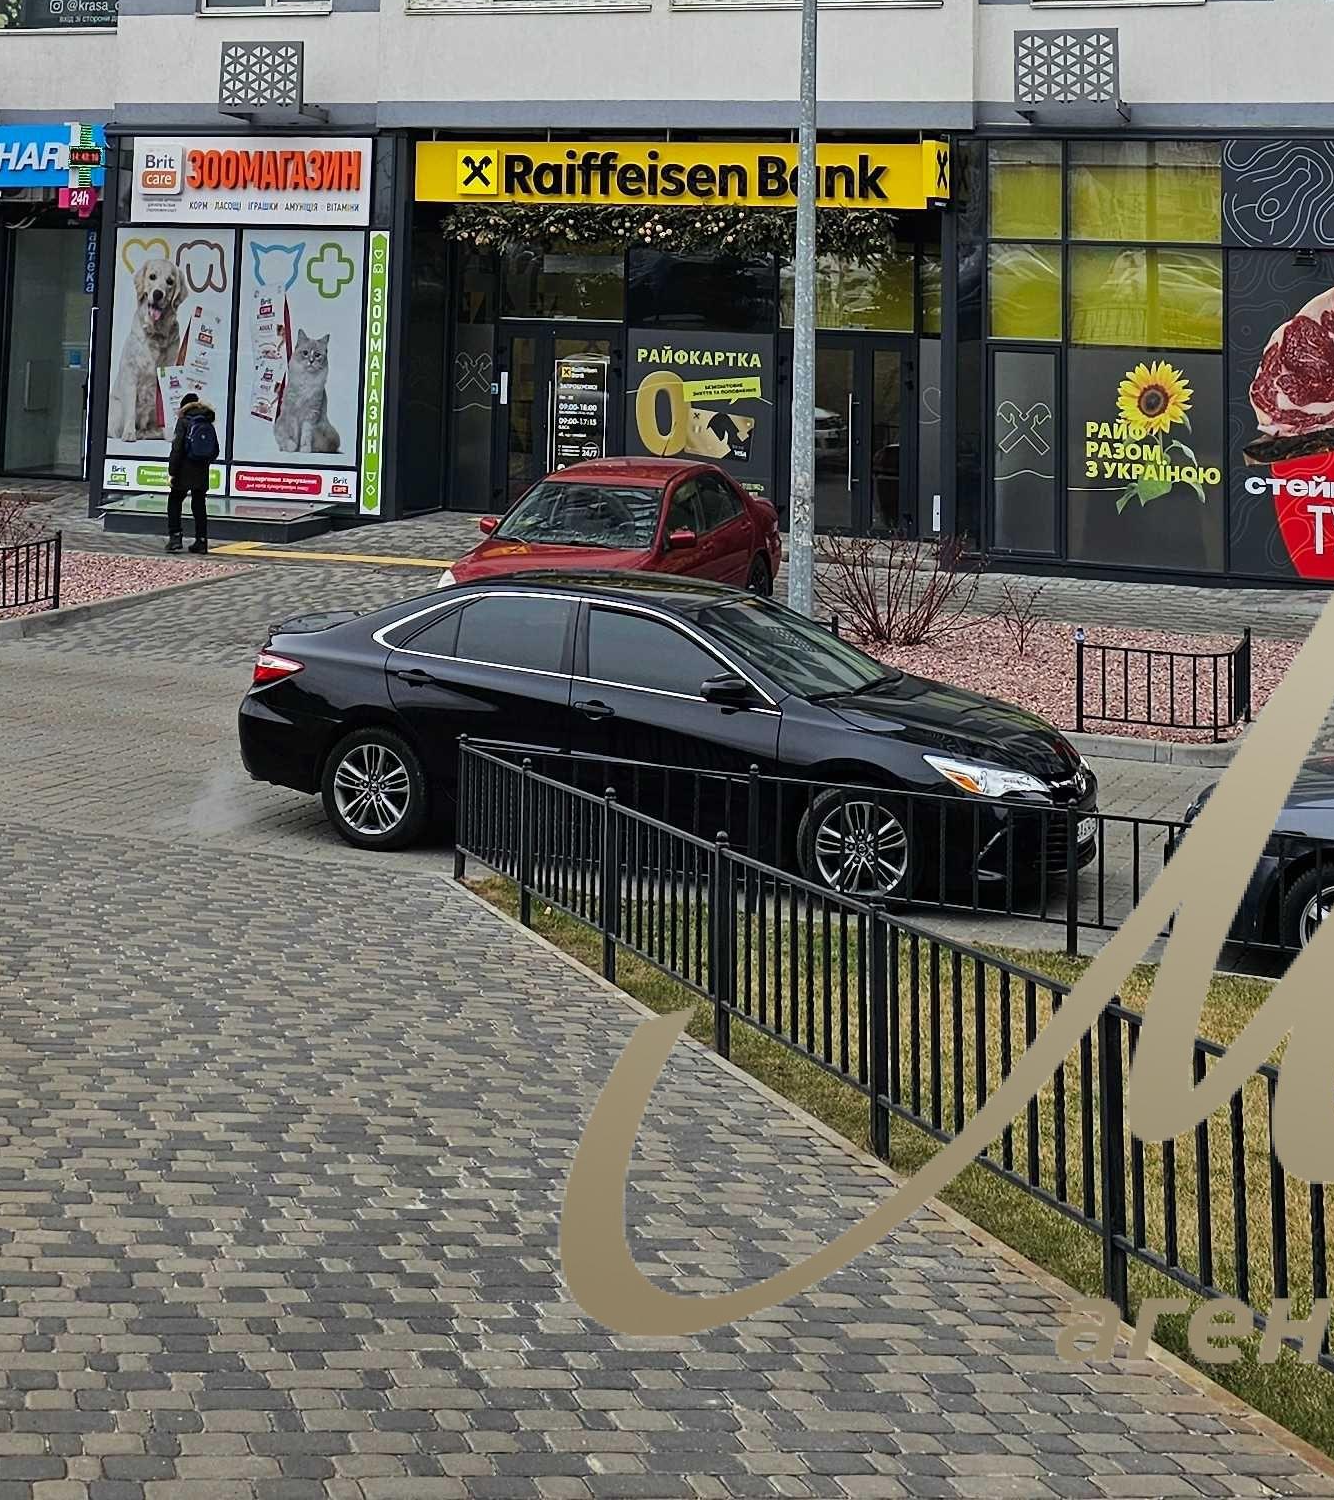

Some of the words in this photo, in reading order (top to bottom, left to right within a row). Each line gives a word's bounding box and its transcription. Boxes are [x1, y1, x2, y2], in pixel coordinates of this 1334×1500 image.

[145, 153, 175, 169] Brit
[186, 149, 362, 191] ЗООМАГАЗИН
[146, 174, 172, 185] care
[504, 149, 749, 198] Raiffeisen
[70, 190, 89, 206] 24h
[86, 231, 97, 293] аптека
[637, 345, 762, 368] РАЙФКАРТКА
[367, 287, 382, 455] ЗООМАГАЗИН
[635, 370, 687, 457] 0
[1085, 419, 1147, 441] РАЙФ
[1085, 441, 1161, 461] РАЗОМ
[332, 476, 348, 484] Brit
[1085, 461, 1098, 478] З
[1103, 460, 1221, 485] УКРАЇНОЮ
